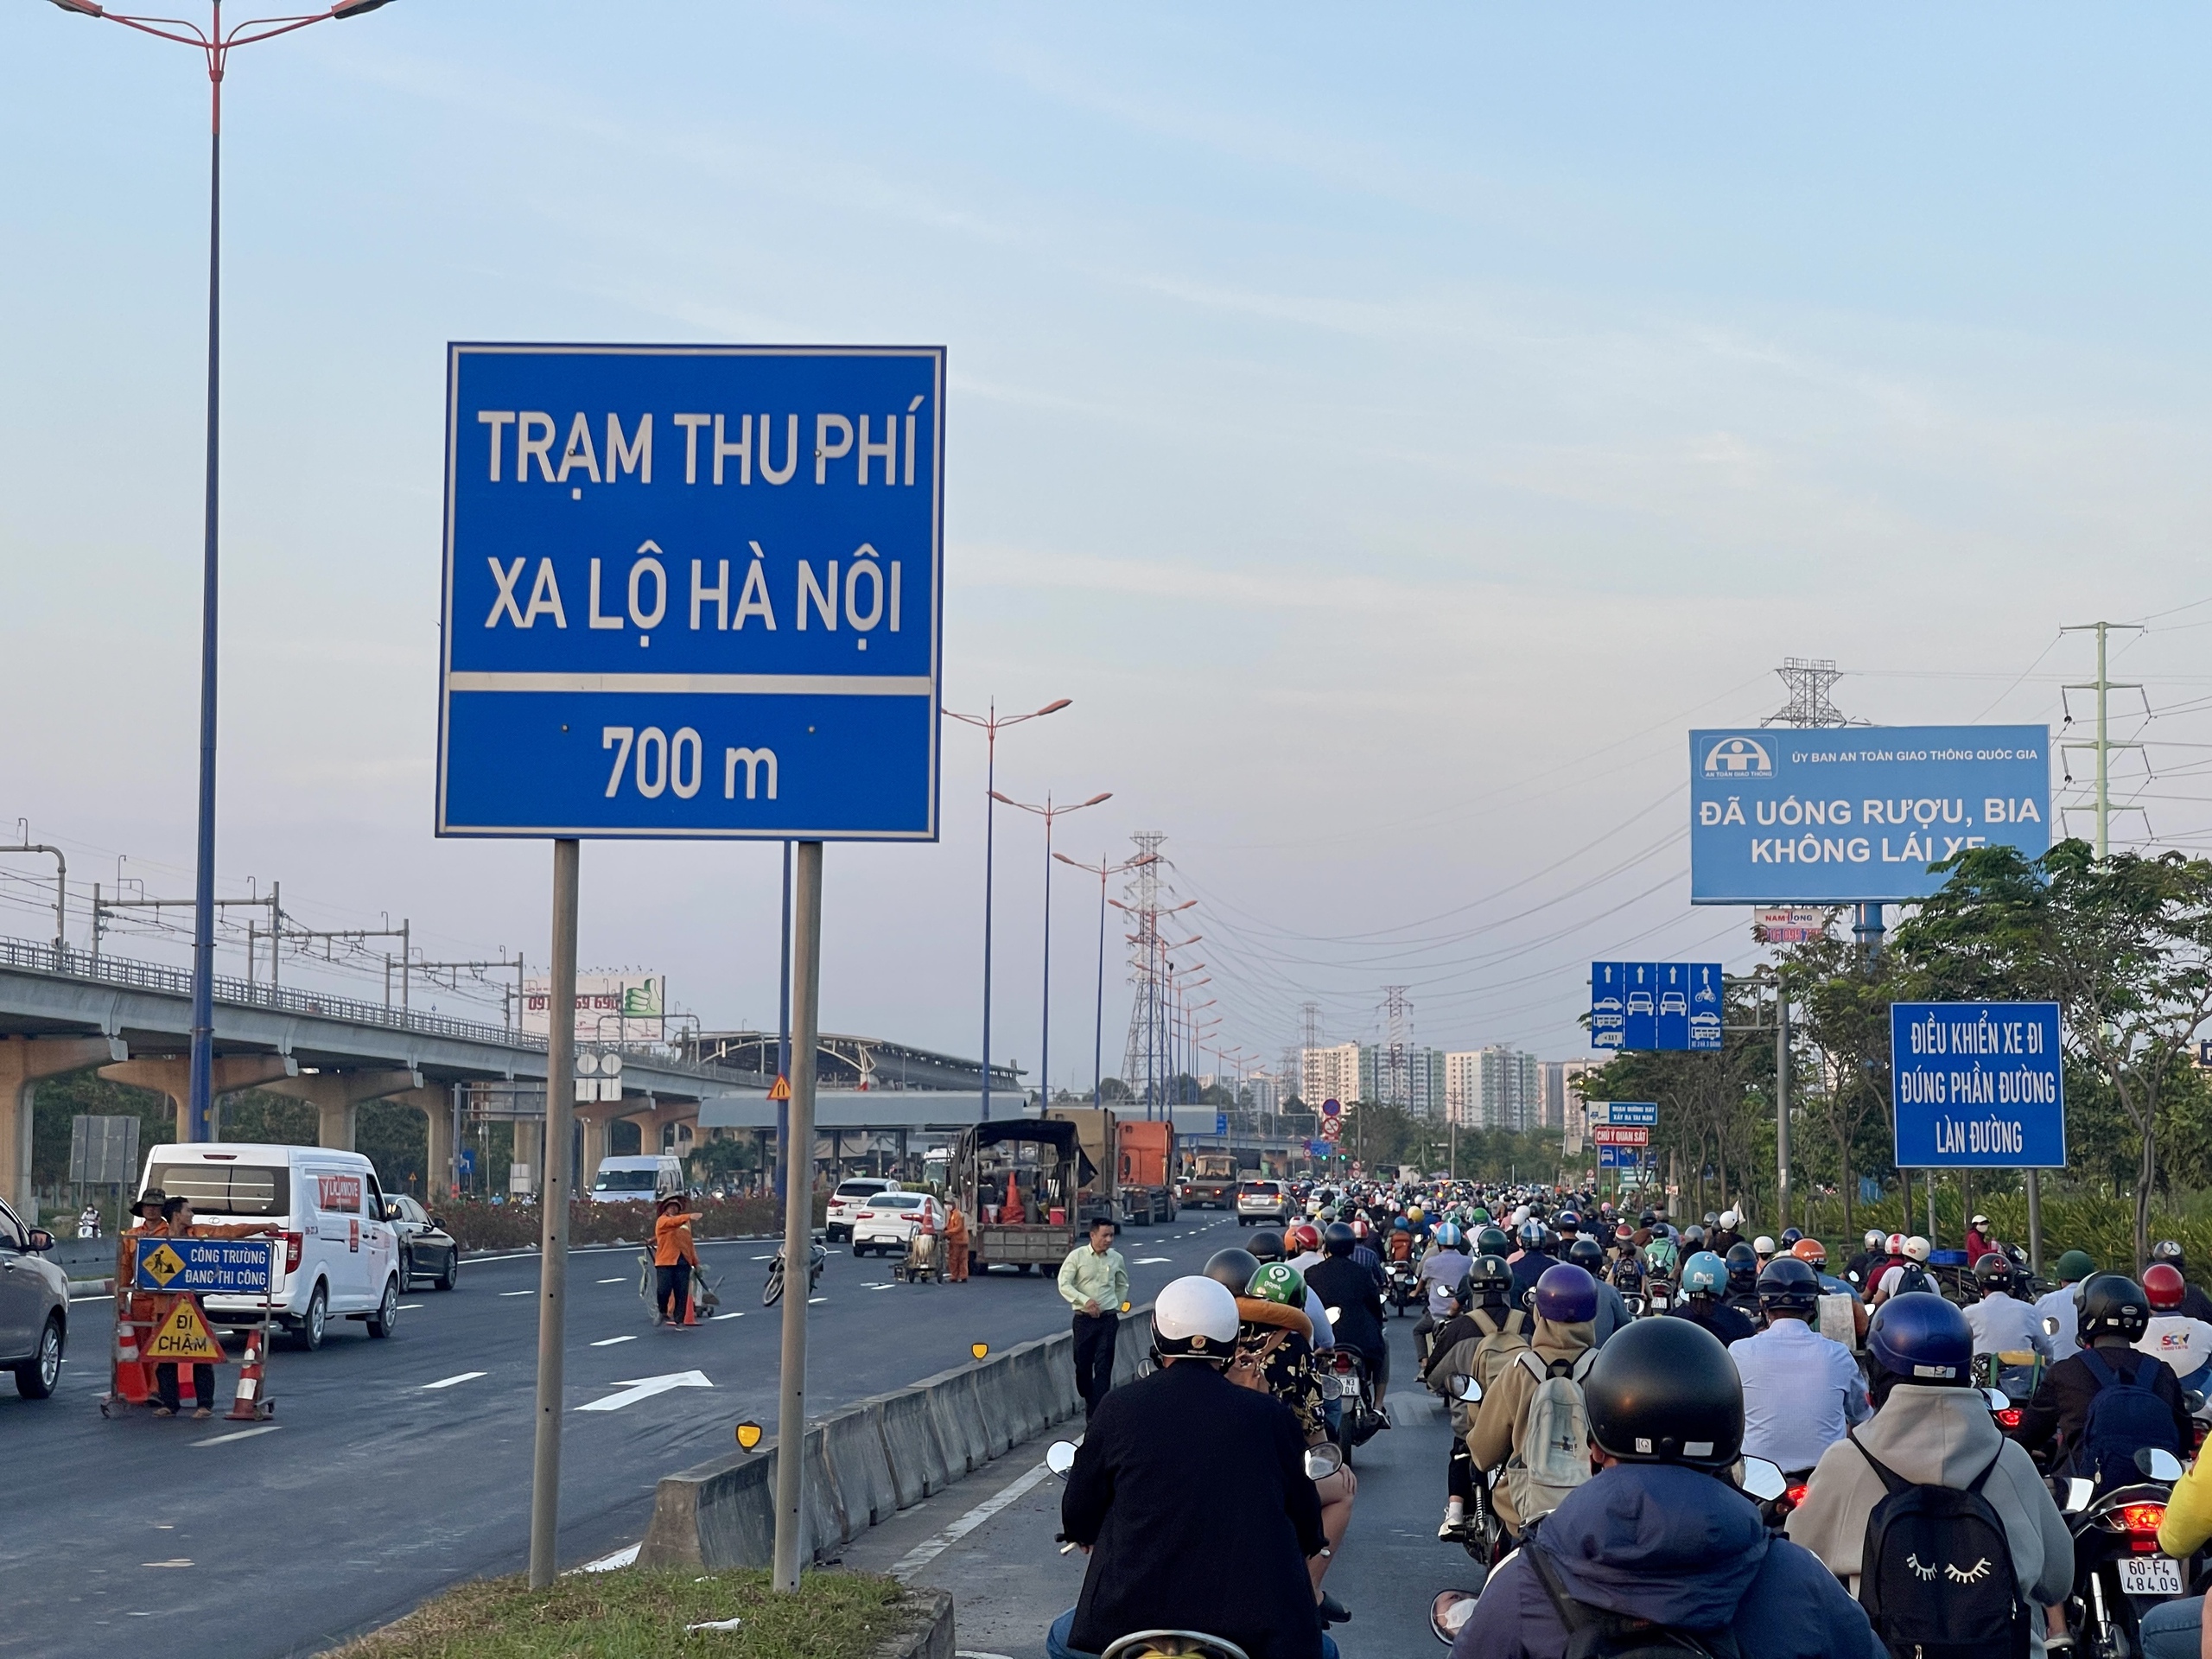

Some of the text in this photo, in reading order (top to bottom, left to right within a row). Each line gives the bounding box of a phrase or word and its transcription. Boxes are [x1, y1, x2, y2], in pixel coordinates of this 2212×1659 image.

[478, 395, 925, 500] TRẠM THU PHÍ
[485, 539, 901, 651] XA LỘ HÀ NỘI
[602, 726, 778, 799] 700 m
[1811, 753, 1836, 762] BAN
[1840, 752, 1858, 762] AN
[1860, 749, 1894, 761] TOÀN
[1897, 751, 1927, 761] GIAO
[1930, 748, 1974, 760] THÔNG
[2016, 749, 2038, 760] GIA
[1700, 797, 1745, 826] ĐÃ
[1863, 798, 1973, 830] RƯỢU,
[1985, 798, 2041, 823] BIA
[1751, 833, 1870, 863] KHÔNG
[1883, 831, 1932, 862] LÁI
[1911, 1009, 2043, 1054] ĐIỀU KHIỂN XE ĐI
[1901, 1061, 2056, 1103] ĐÚNG PHẦN ĐƯỜNG
[1616, 1131, 1633, 1142] QUAN
[1936, 1114, 2023, 1153] LÀN ĐƯỜNG
[191, 1246, 266, 1264] CÔNG TRƯỜNG
[218, 1270, 234, 1285] THI
[237, 1269, 266, 1286] CÔNG
[176, 1315, 193, 1330] ĐI
[158, 1333, 207, 1355] CHẬM
[2129, 1561, 2170, 1575] 60-F4
[2127, 1577, 2178, 1592] 484.09
